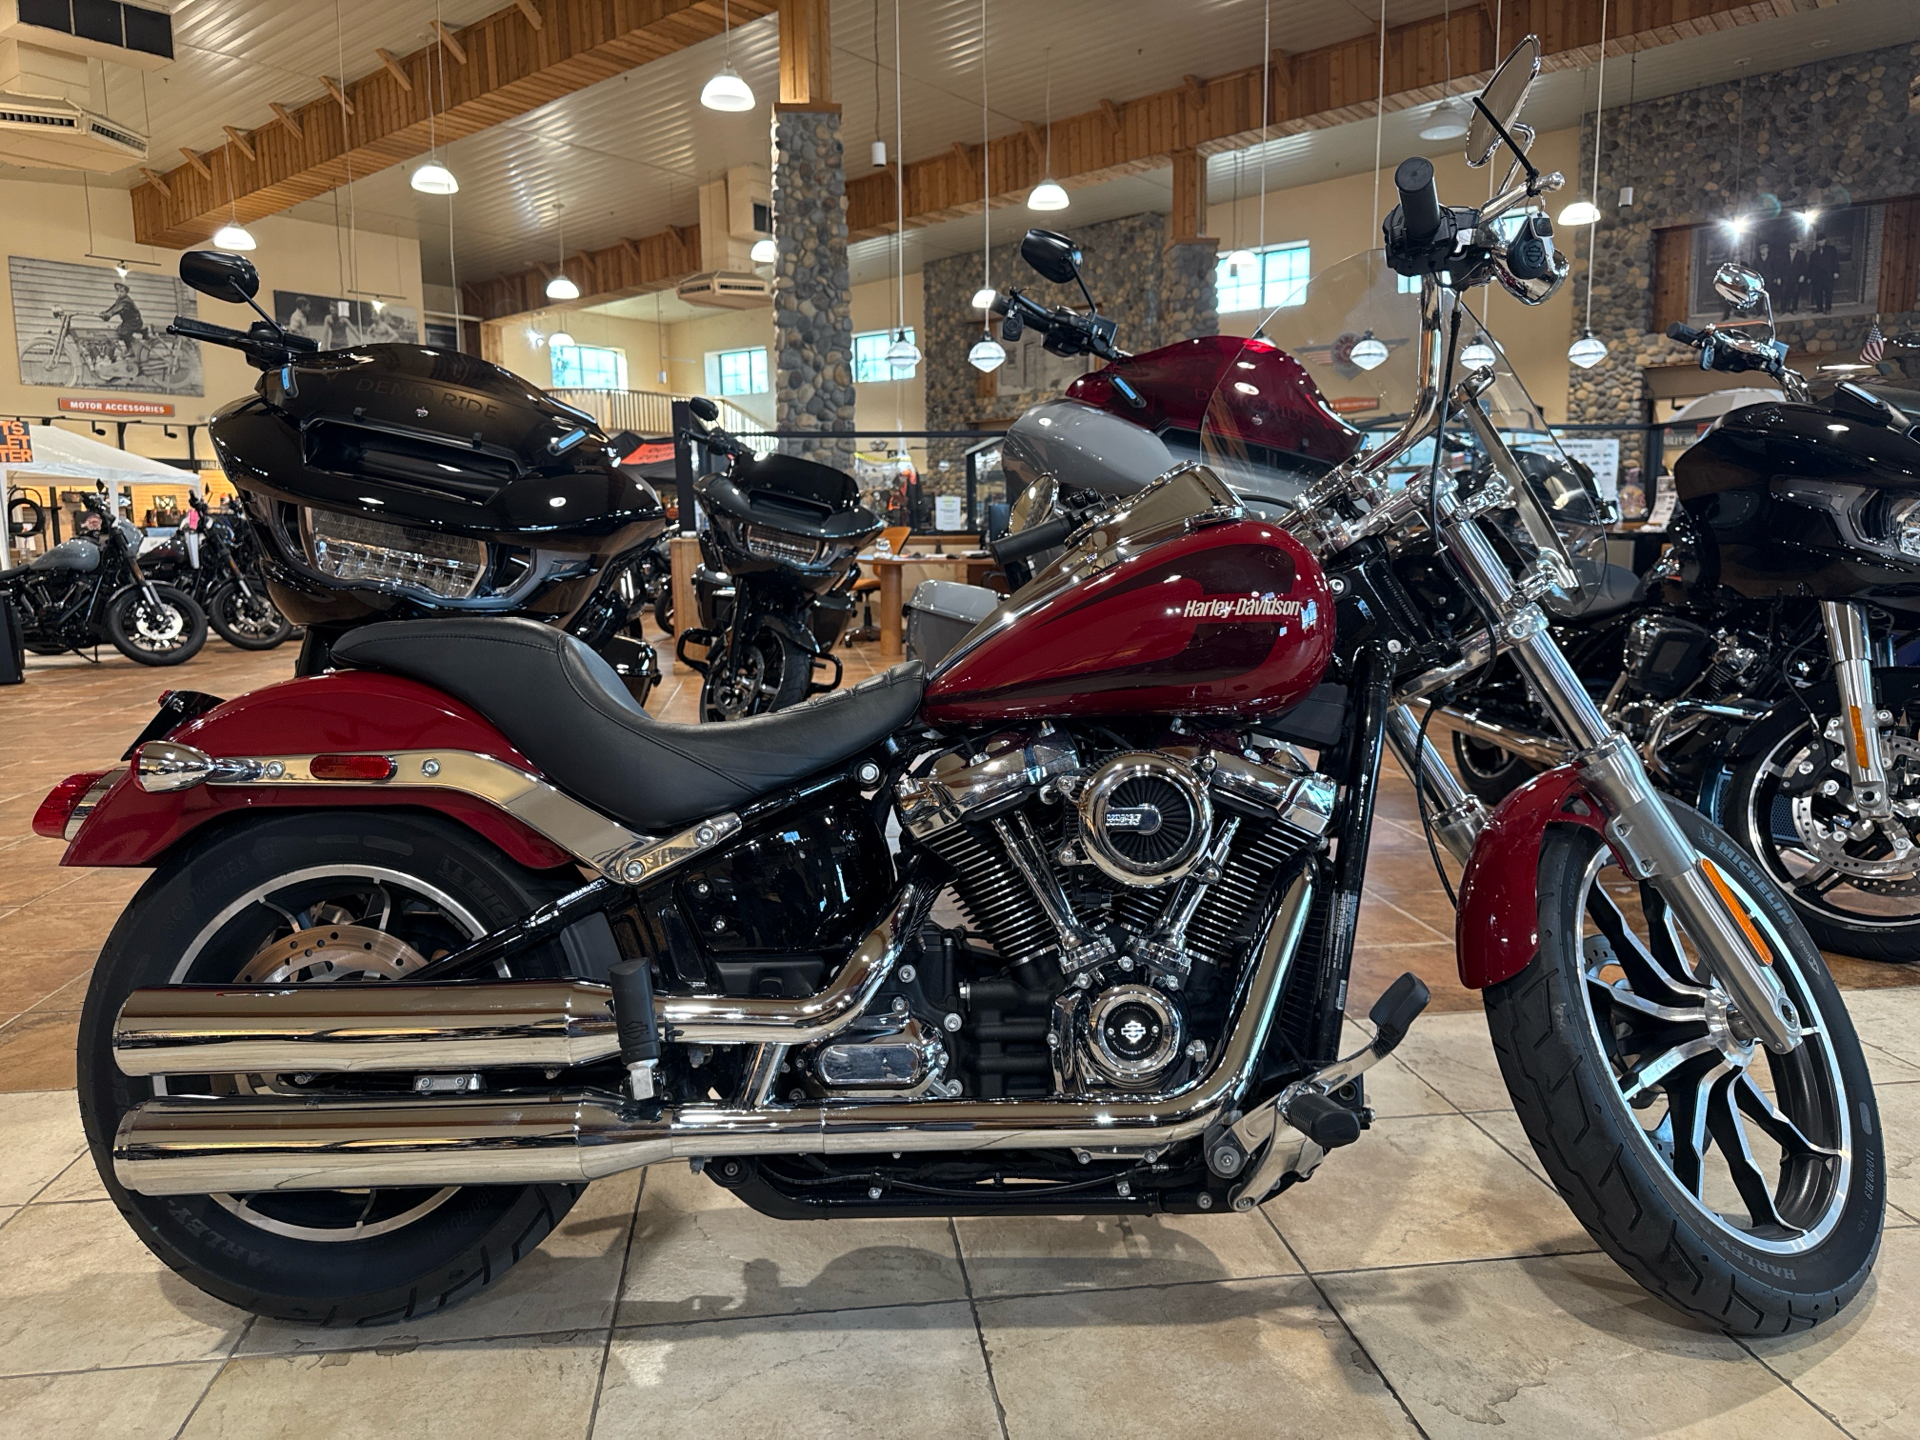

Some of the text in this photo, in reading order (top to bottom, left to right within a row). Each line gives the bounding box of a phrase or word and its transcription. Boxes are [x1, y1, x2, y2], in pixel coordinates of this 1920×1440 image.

[69, 400, 165, 414] MOTOR ACCESSORIES
[442, 392, 499, 420] RIDE
[1183, 598, 1301, 619] Harley-Davidson
[1717, 840, 1793, 926] MICHELIN
